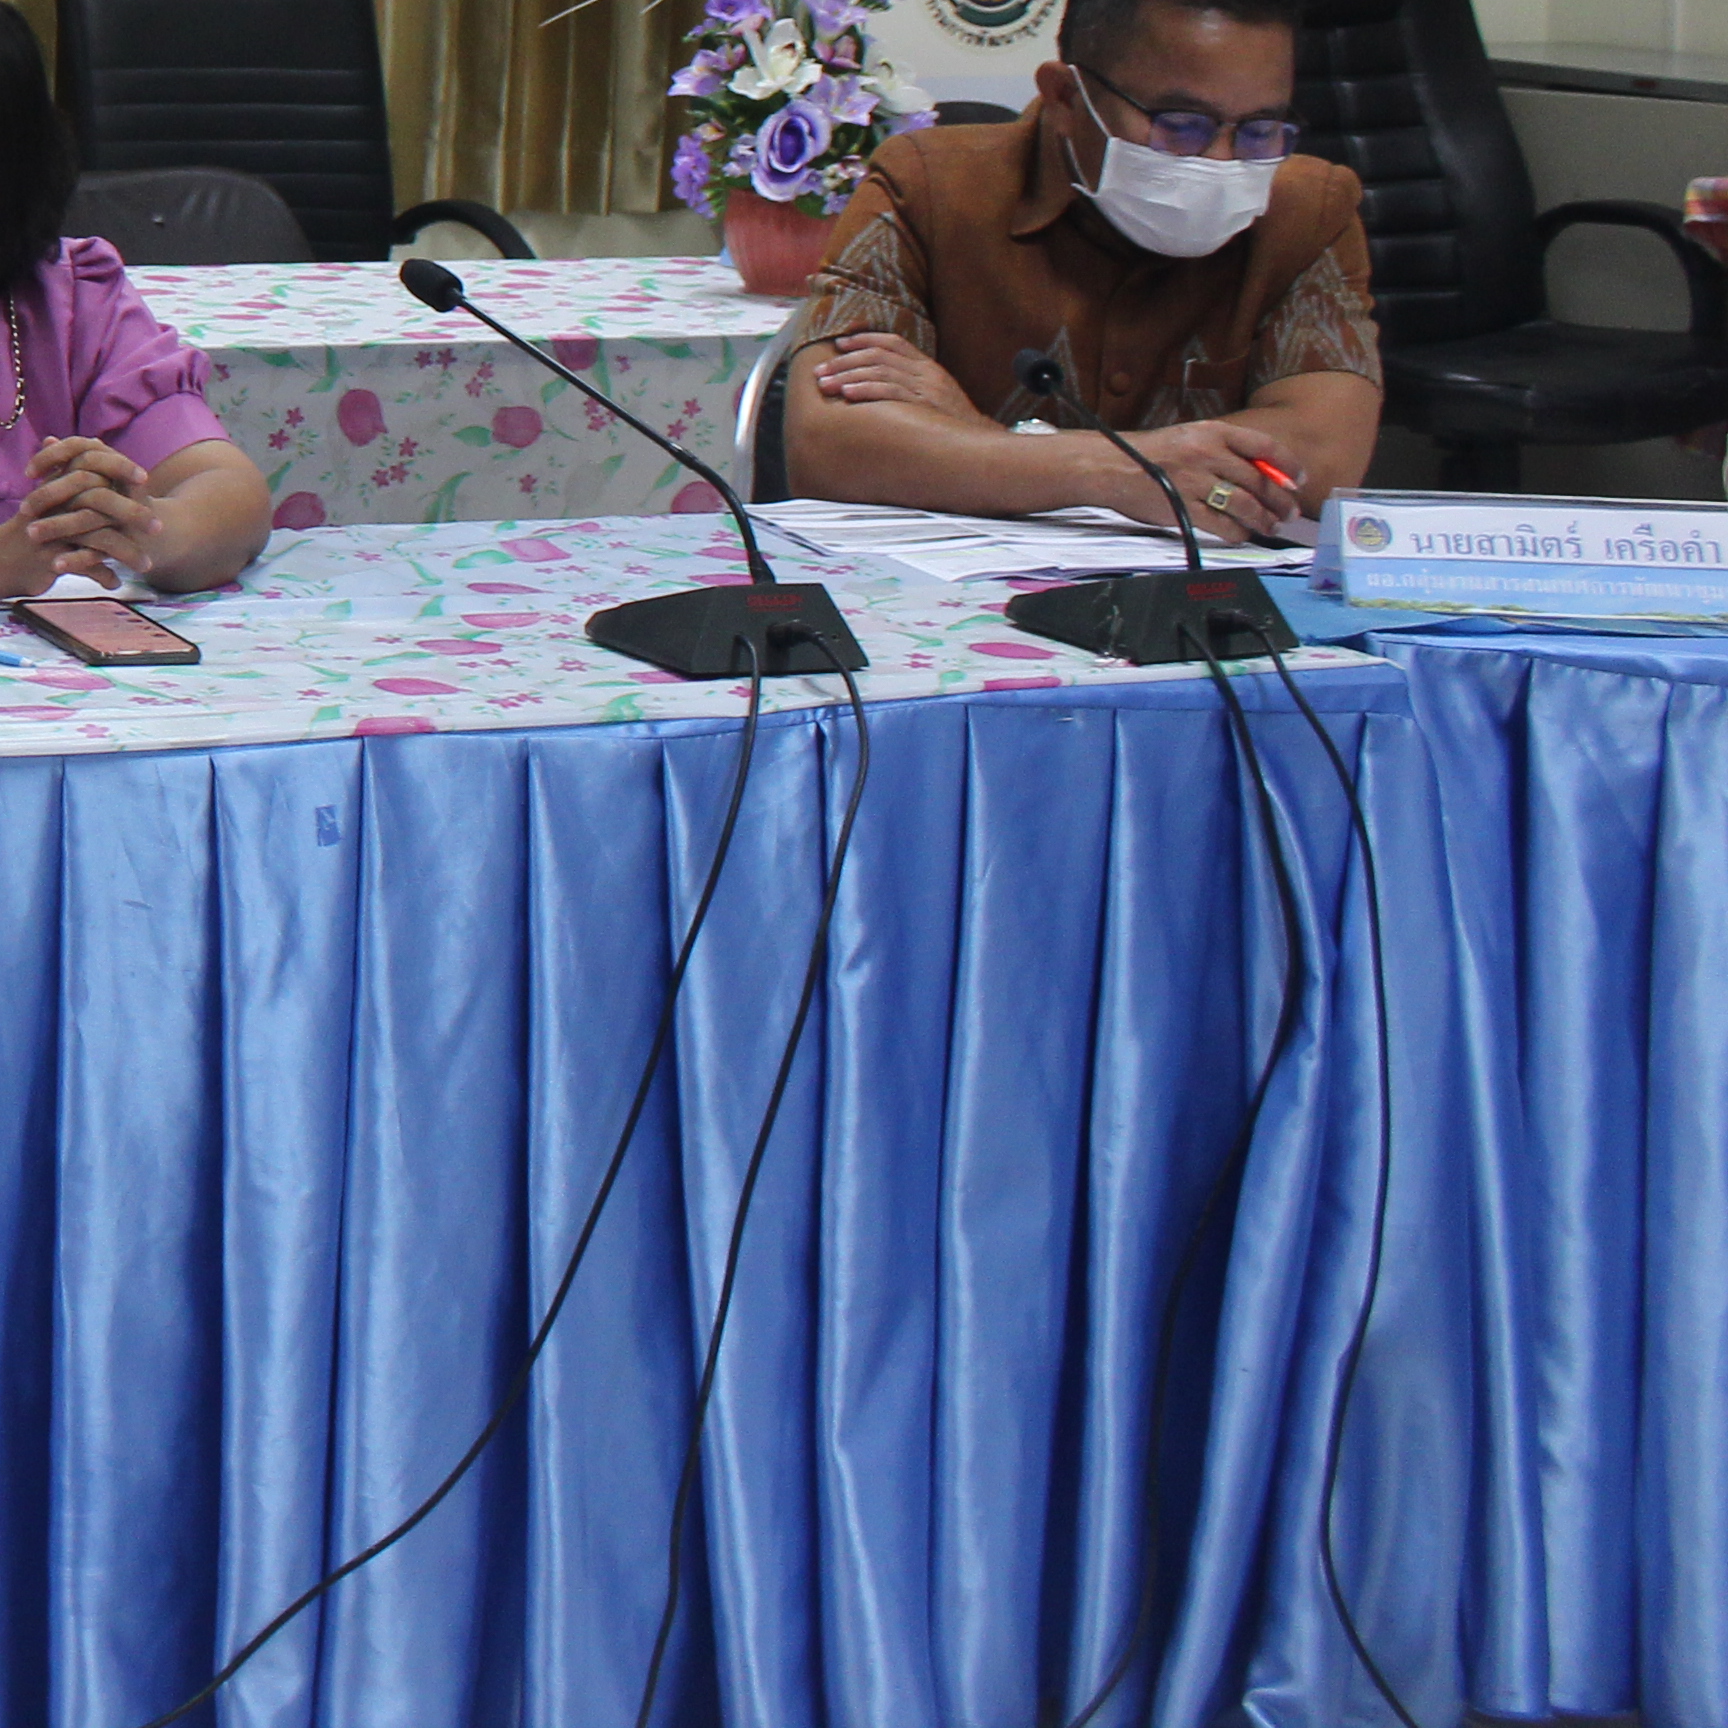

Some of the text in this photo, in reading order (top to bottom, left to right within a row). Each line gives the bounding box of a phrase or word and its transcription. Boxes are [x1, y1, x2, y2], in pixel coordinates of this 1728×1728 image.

[1409, 521, 1721, 563] นายสามิตร์ เครือคำ
